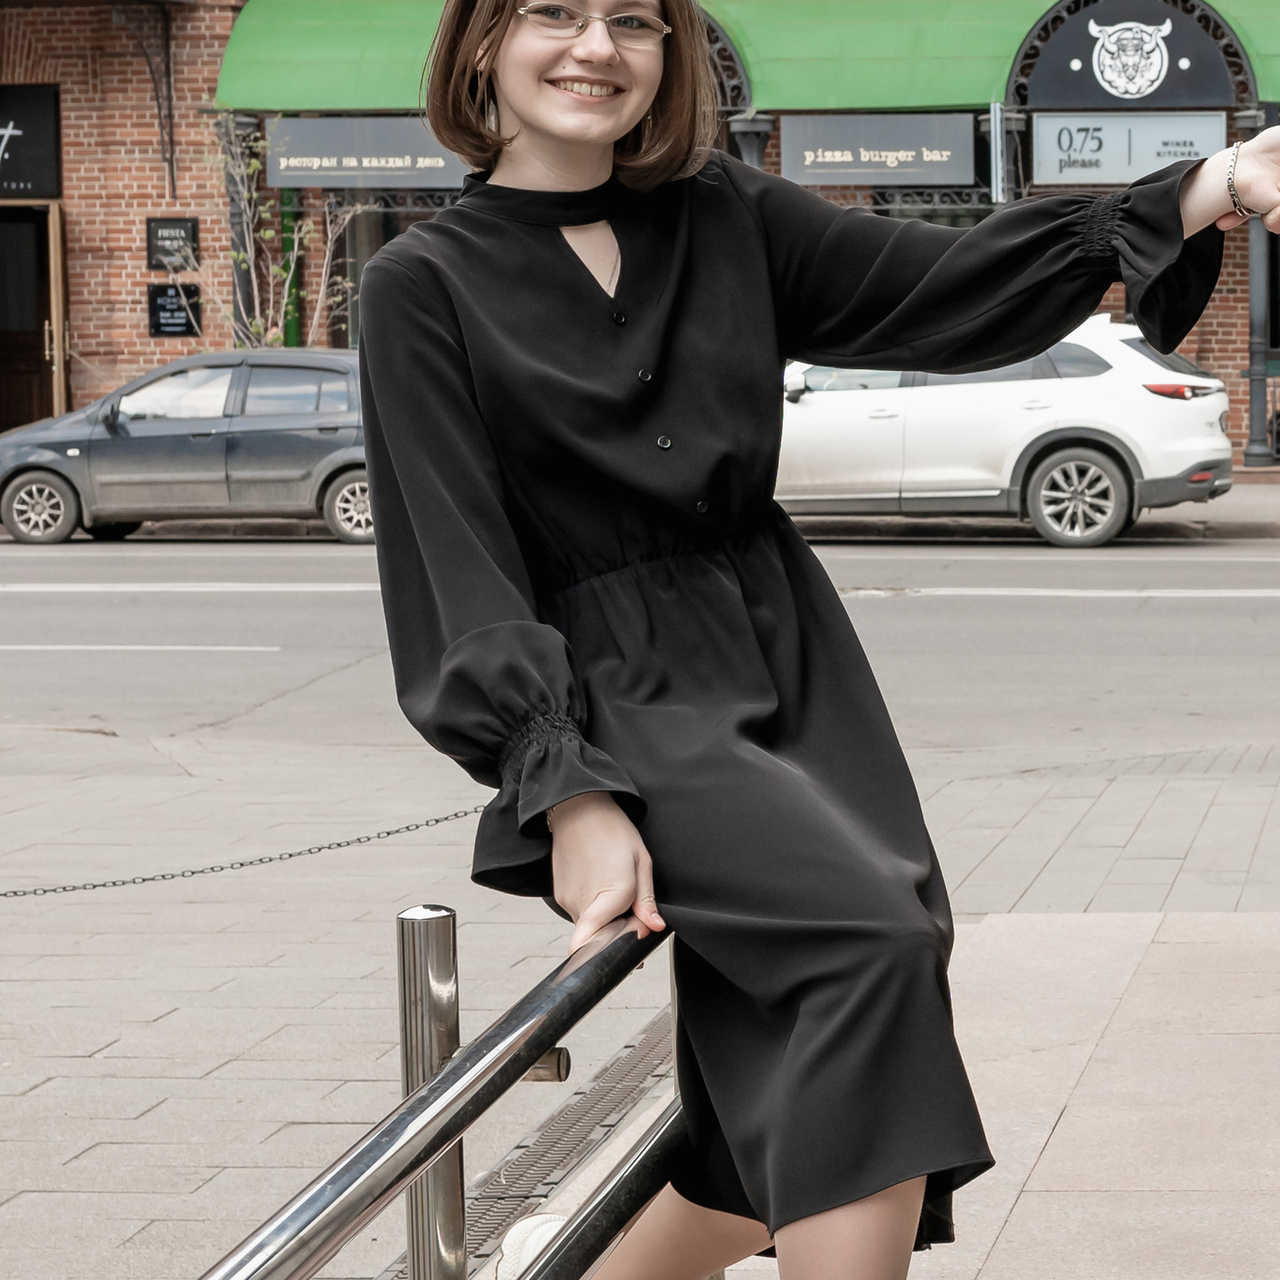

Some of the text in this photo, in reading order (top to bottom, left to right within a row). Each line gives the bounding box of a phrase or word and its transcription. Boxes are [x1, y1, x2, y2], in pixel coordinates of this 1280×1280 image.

[1057, 127, 1103, 154] 0.75
[279, 155, 445, 169] ресторан на каждый день
[804, 147, 951, 167] pizza burger bar
[1059, 154, 1101, 174] please
